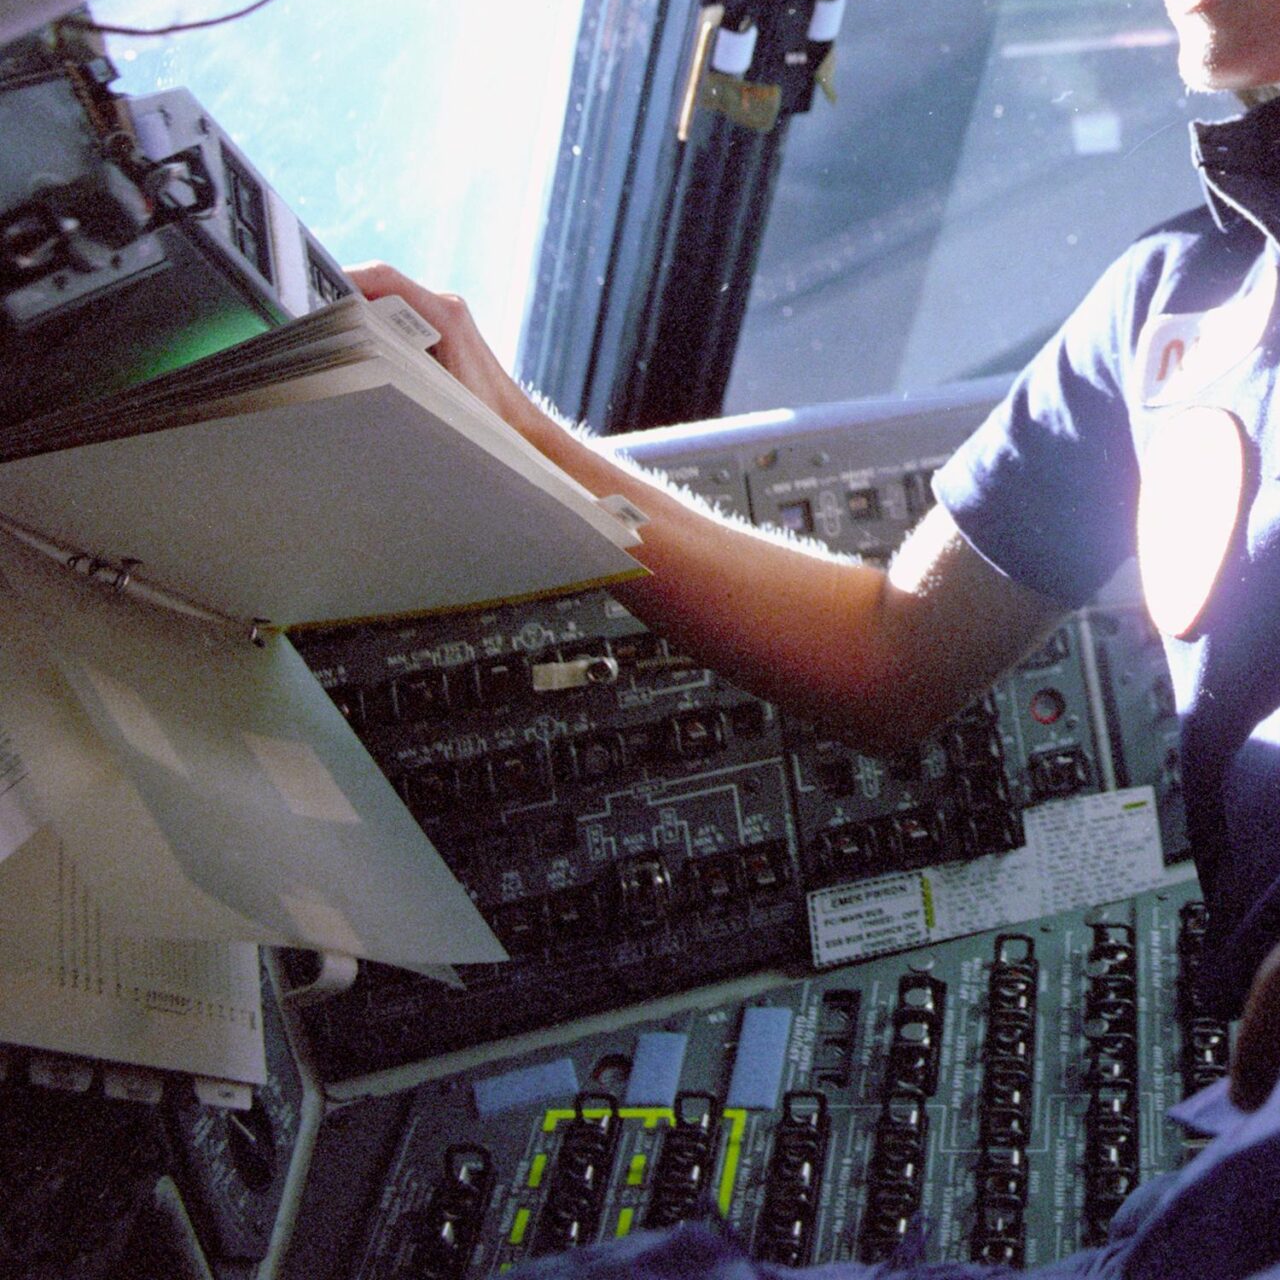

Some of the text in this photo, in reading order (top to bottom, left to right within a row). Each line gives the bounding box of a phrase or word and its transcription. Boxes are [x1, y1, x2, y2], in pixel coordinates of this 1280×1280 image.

[834, 1164, 851, 1218] ISOLATION
[1053, 1137, 1068, 1207] INTERCONNECT
[938, 1186, 954, 1248] PNEUMATICS
